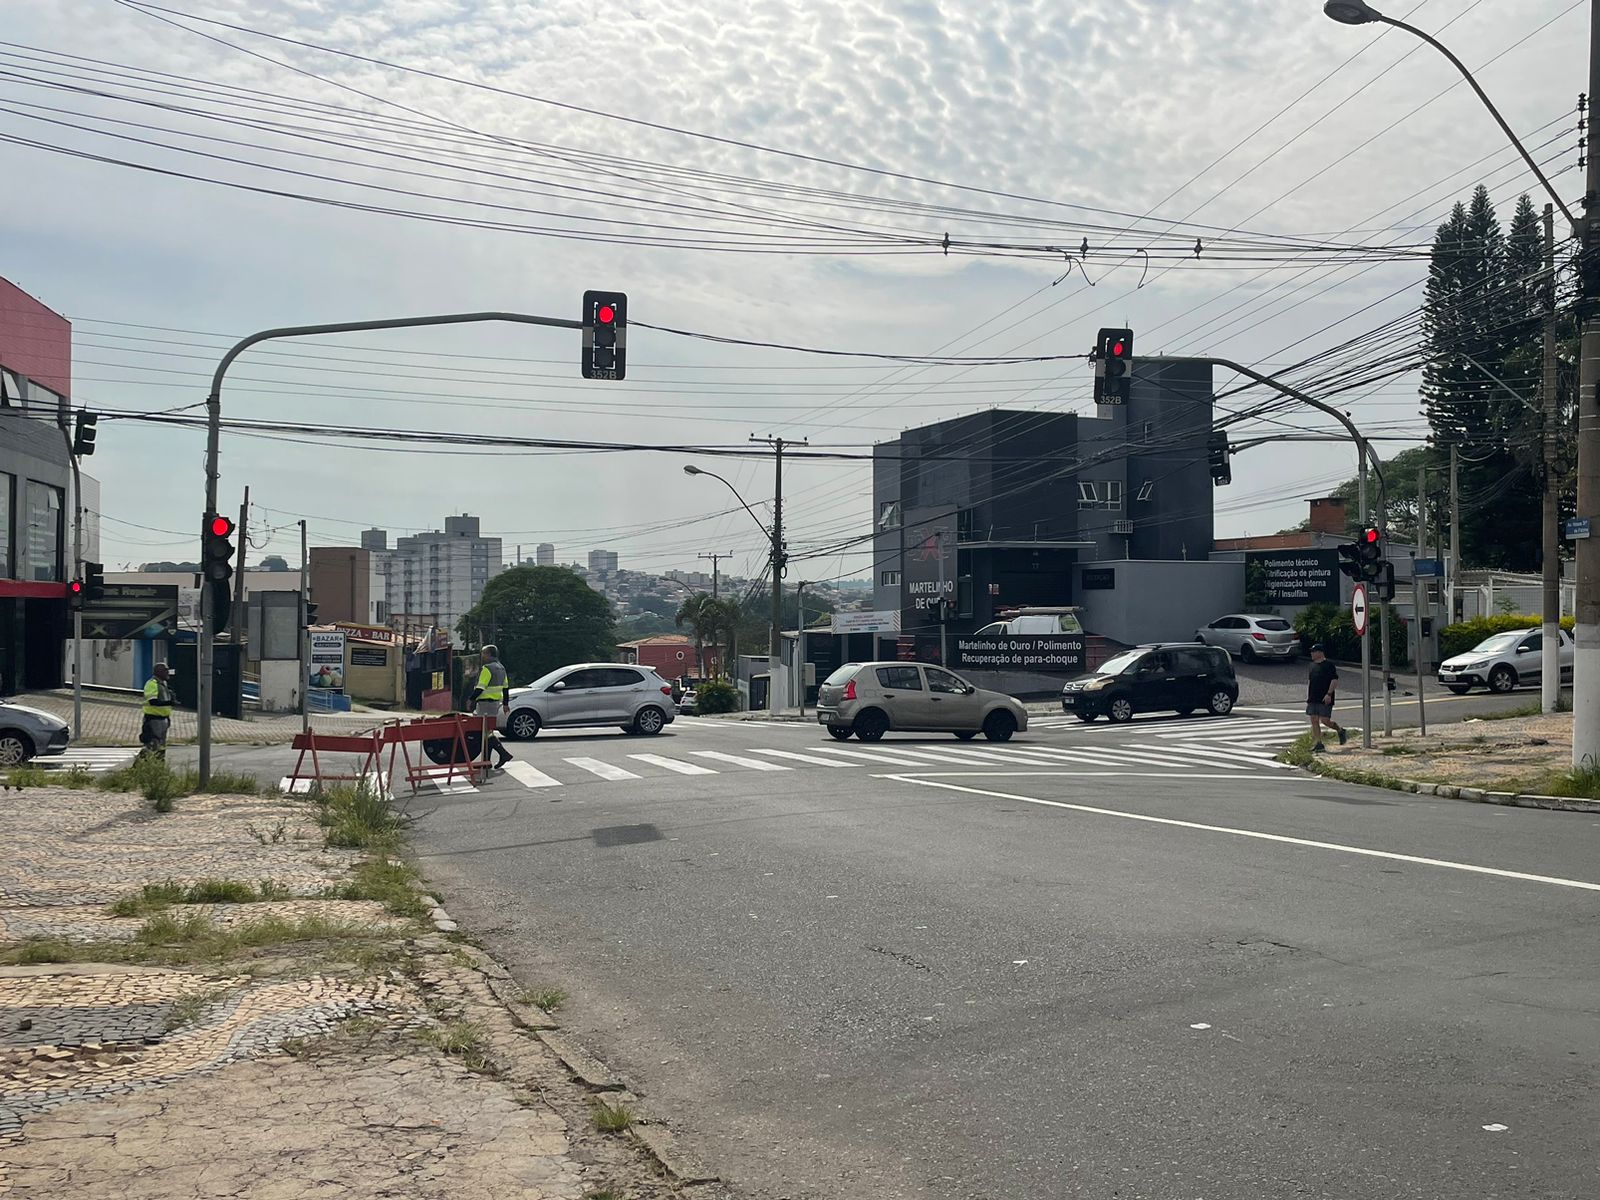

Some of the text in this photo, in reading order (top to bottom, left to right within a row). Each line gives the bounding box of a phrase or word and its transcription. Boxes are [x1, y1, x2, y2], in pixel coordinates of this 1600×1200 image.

[590, 370, 617, 379] 352B
[1100, 395, 1122, 404] 352B
[1296, 558, 1318, 566] técnico
[1308, 569, 1331, 578] pintura
[1281, 589, 1308, 598] Insulfilm
[915, 597, 947, 610] DE OU
[372, 631, 390, 641] BAR
[958, 640, 996, 650] Martelinho
[997, 640, 1008, 650] de
[1009, 640, 1031, 650] Ouro
[1038, 640, 1082, 651] Polimento
[961, 653, 1078, 666] Recuperação de para-choque
